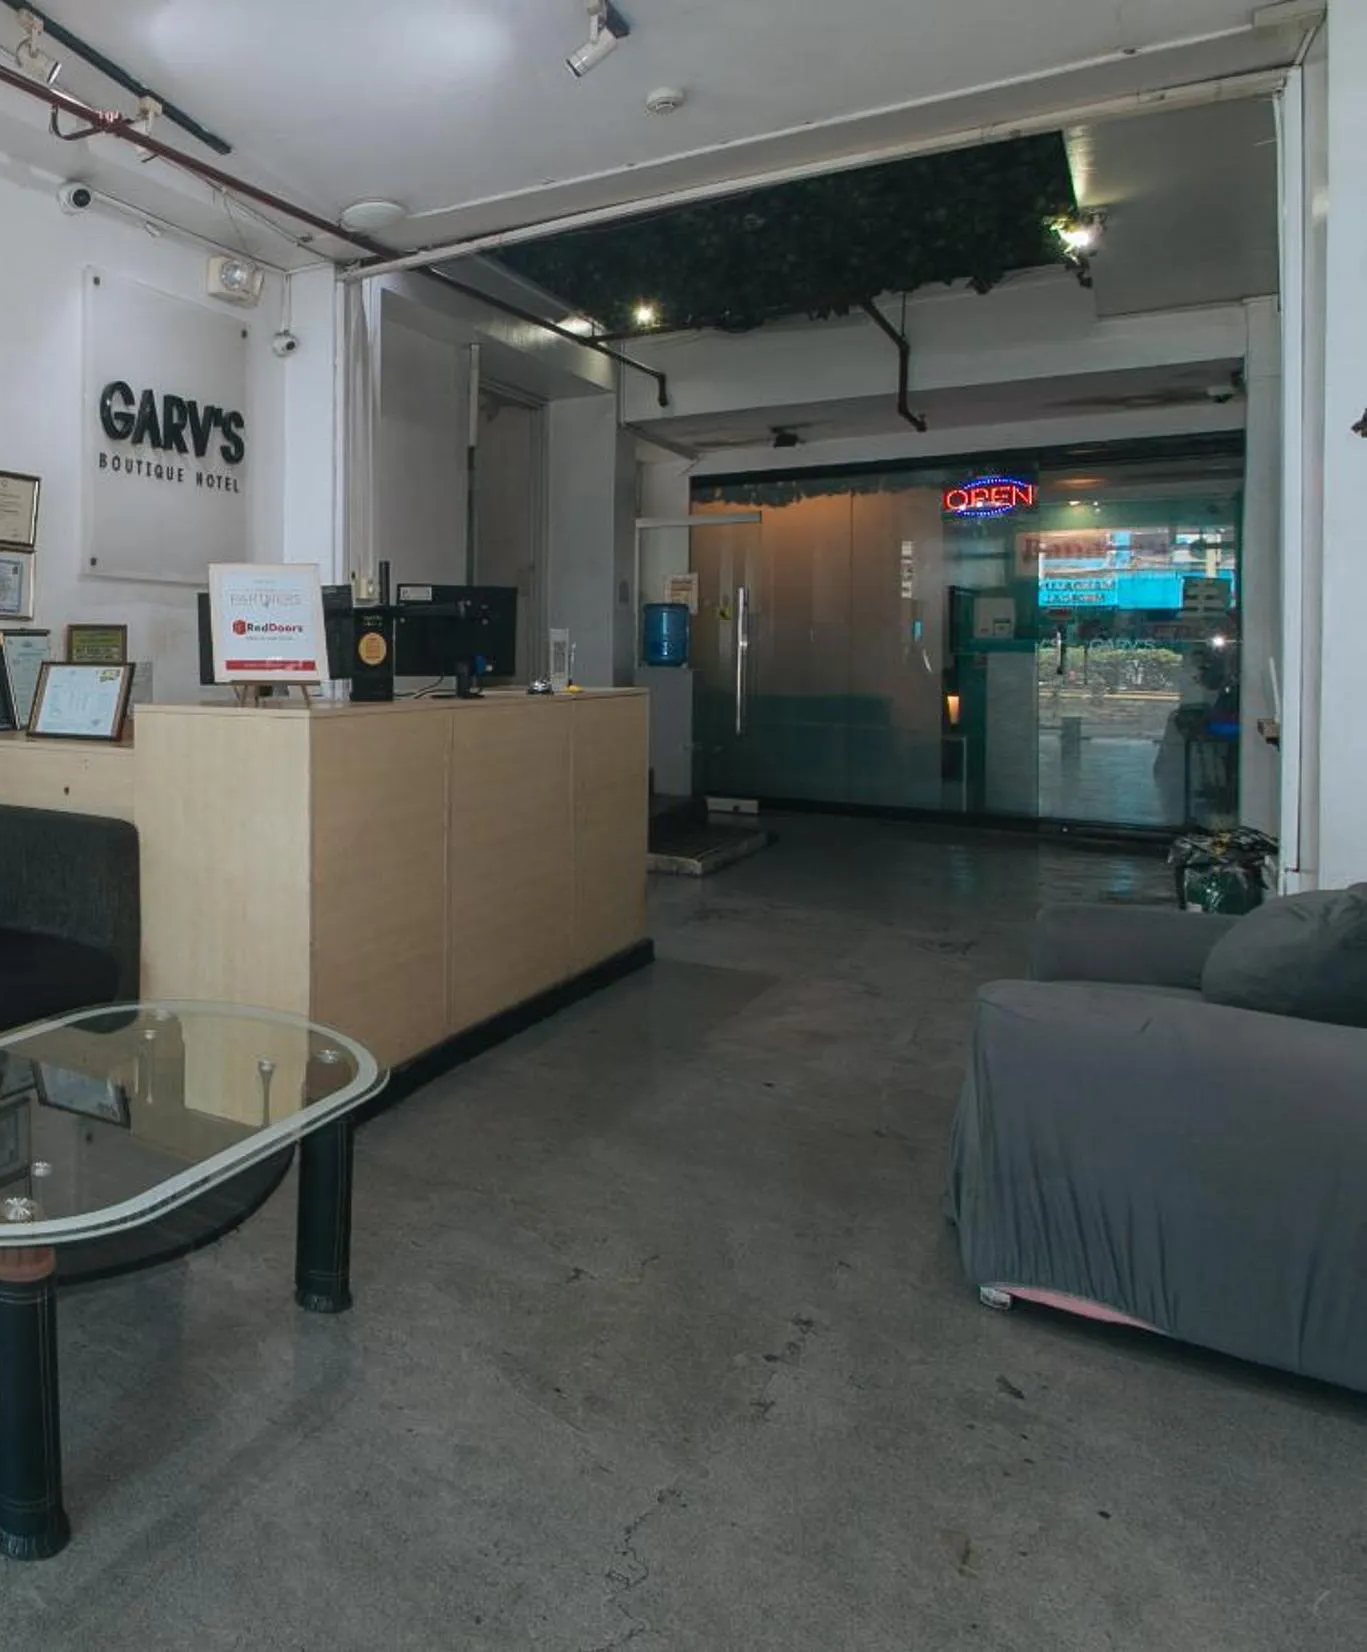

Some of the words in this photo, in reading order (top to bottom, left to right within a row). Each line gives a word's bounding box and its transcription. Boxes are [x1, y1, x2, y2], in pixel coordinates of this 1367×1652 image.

[99, 380, 245, 465] GARV'S
[98, 452, 184, 483] BOUTIQUE
[195, 471, 240, 494] HOTEL
[944, 483, 1034, 512] OPEN
